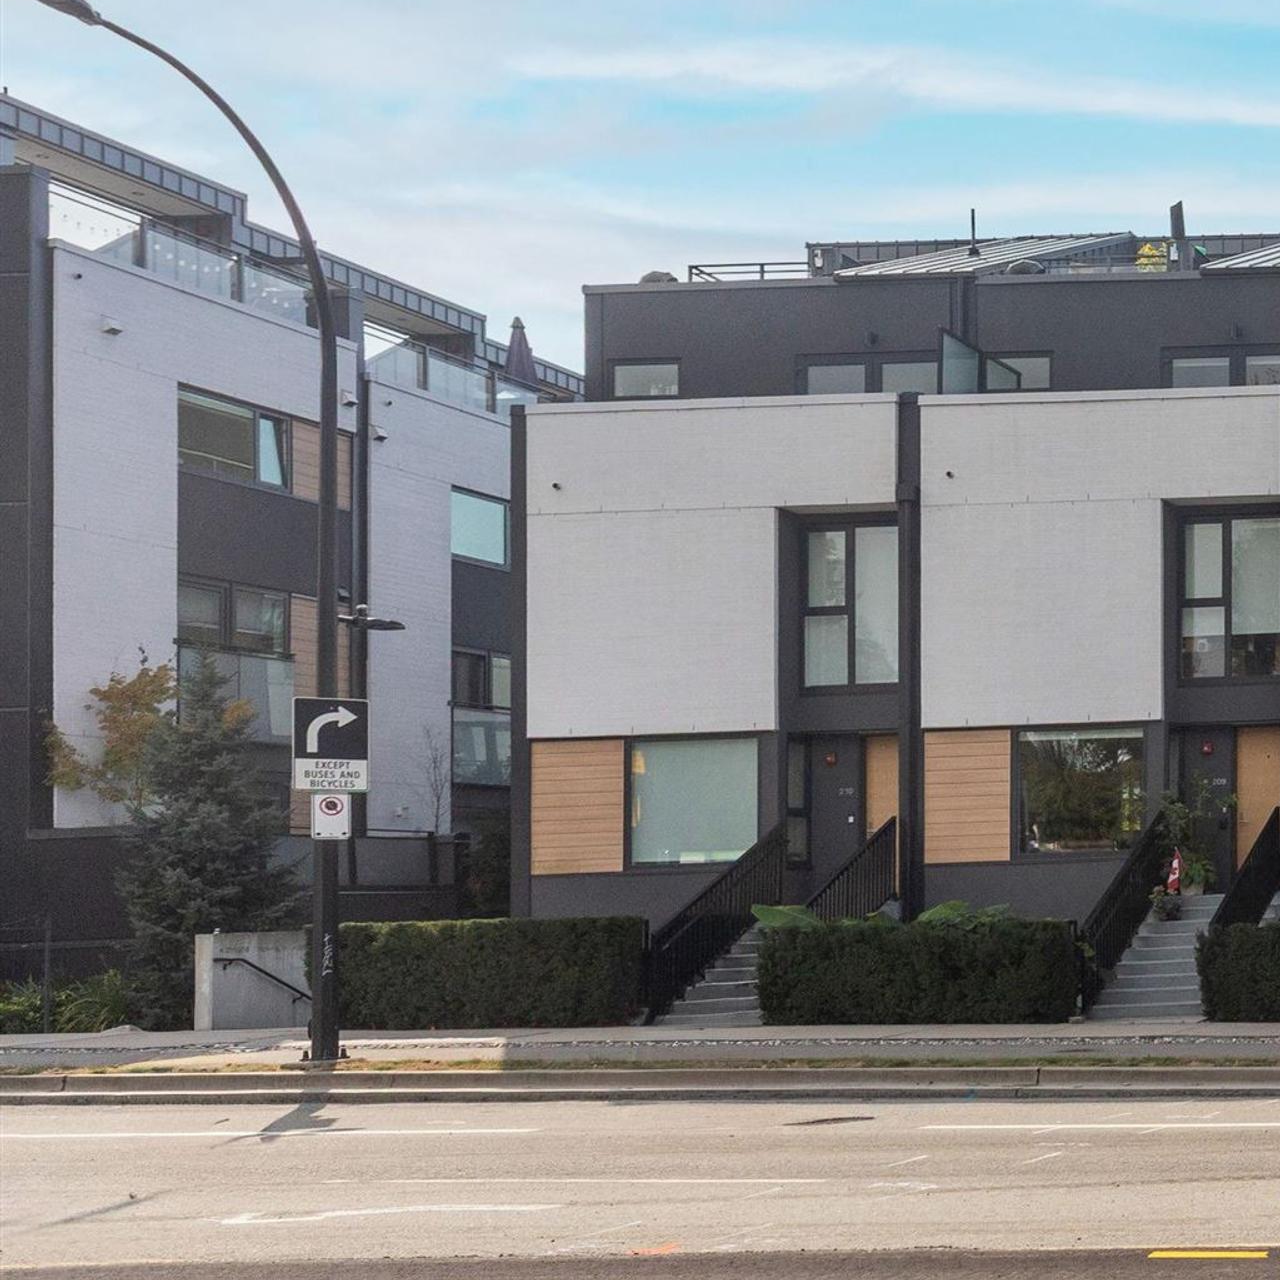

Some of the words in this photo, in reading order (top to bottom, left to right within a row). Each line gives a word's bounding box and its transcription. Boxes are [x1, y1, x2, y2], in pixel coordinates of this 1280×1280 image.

[315, 761, 351, 769] EXCEPT
[304, 770, 335, 778] BUSES
[339, 770, 360, 779] AND
[310, 780, 356, 788] BICYCLES
